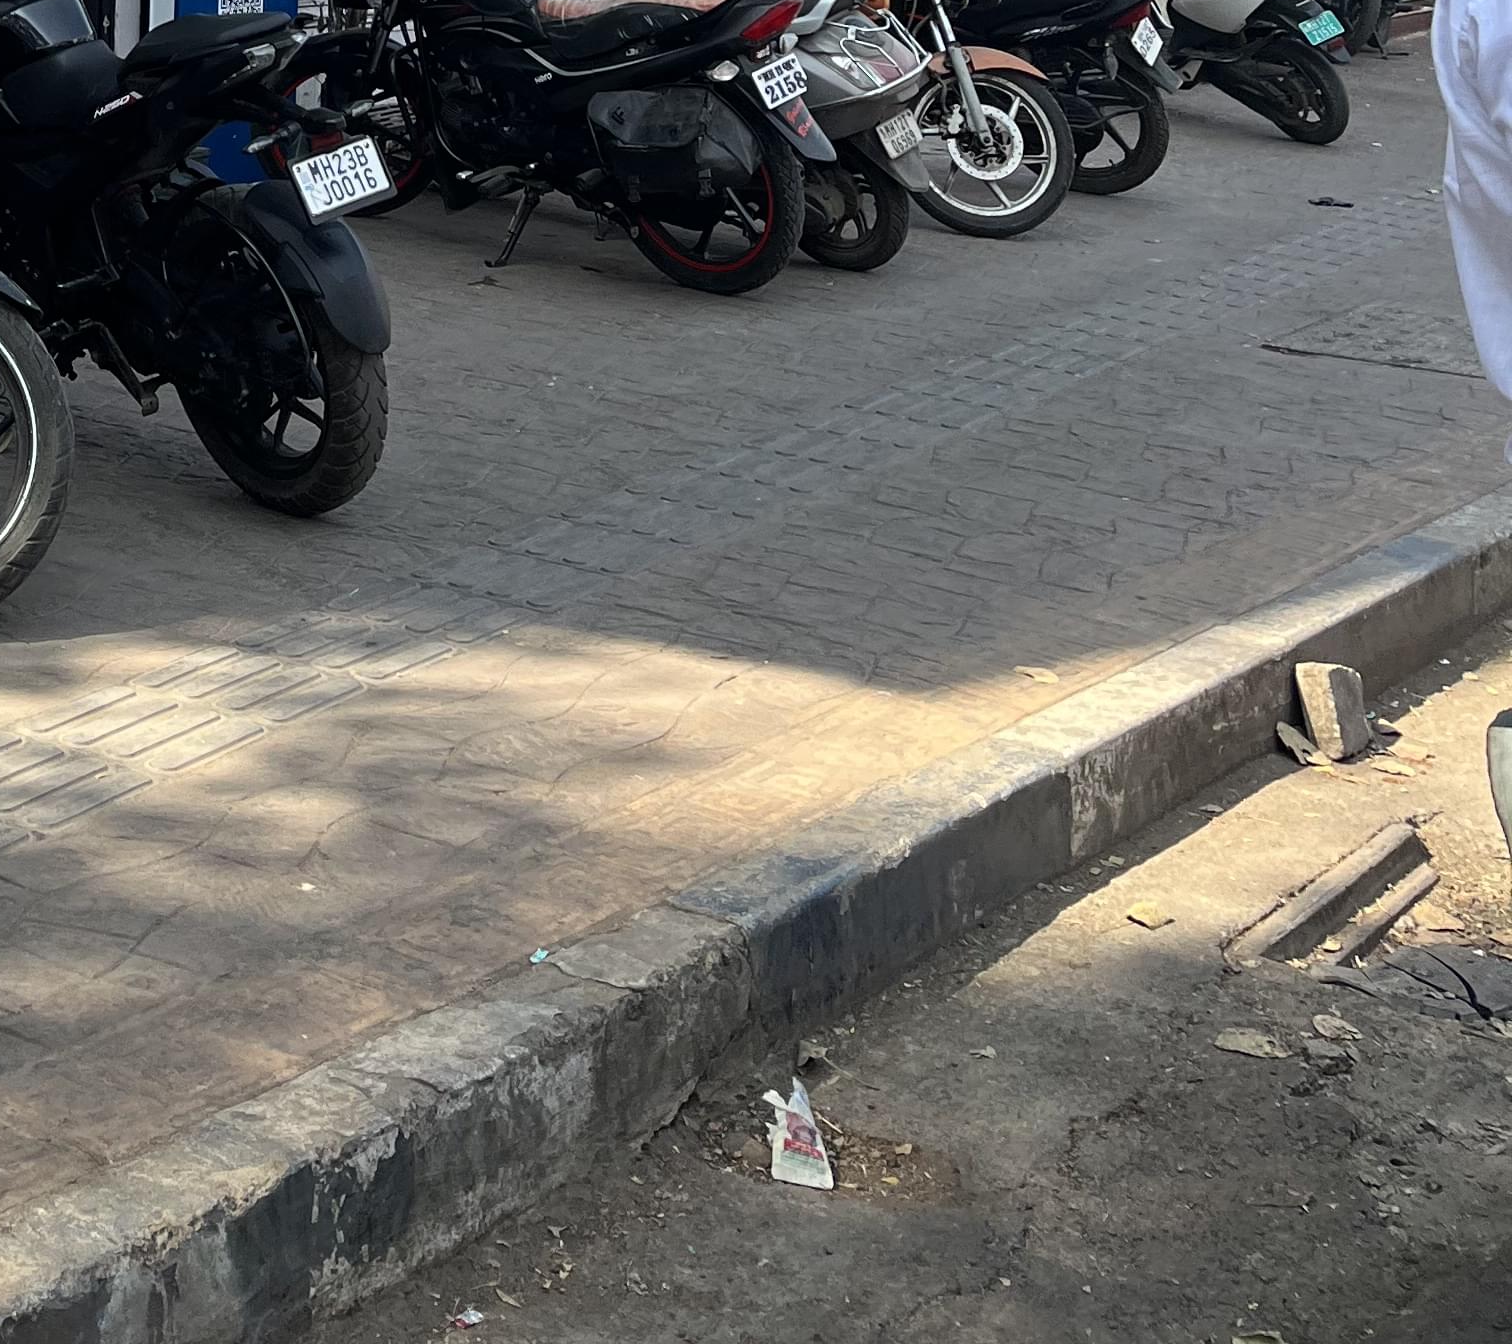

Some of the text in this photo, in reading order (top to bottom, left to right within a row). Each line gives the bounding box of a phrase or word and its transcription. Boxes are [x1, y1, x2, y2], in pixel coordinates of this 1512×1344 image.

[765, 71, 808, 105] 2158
[307, 145, 369, 184] MH23B
[322, 168, 378, 206] J0016
